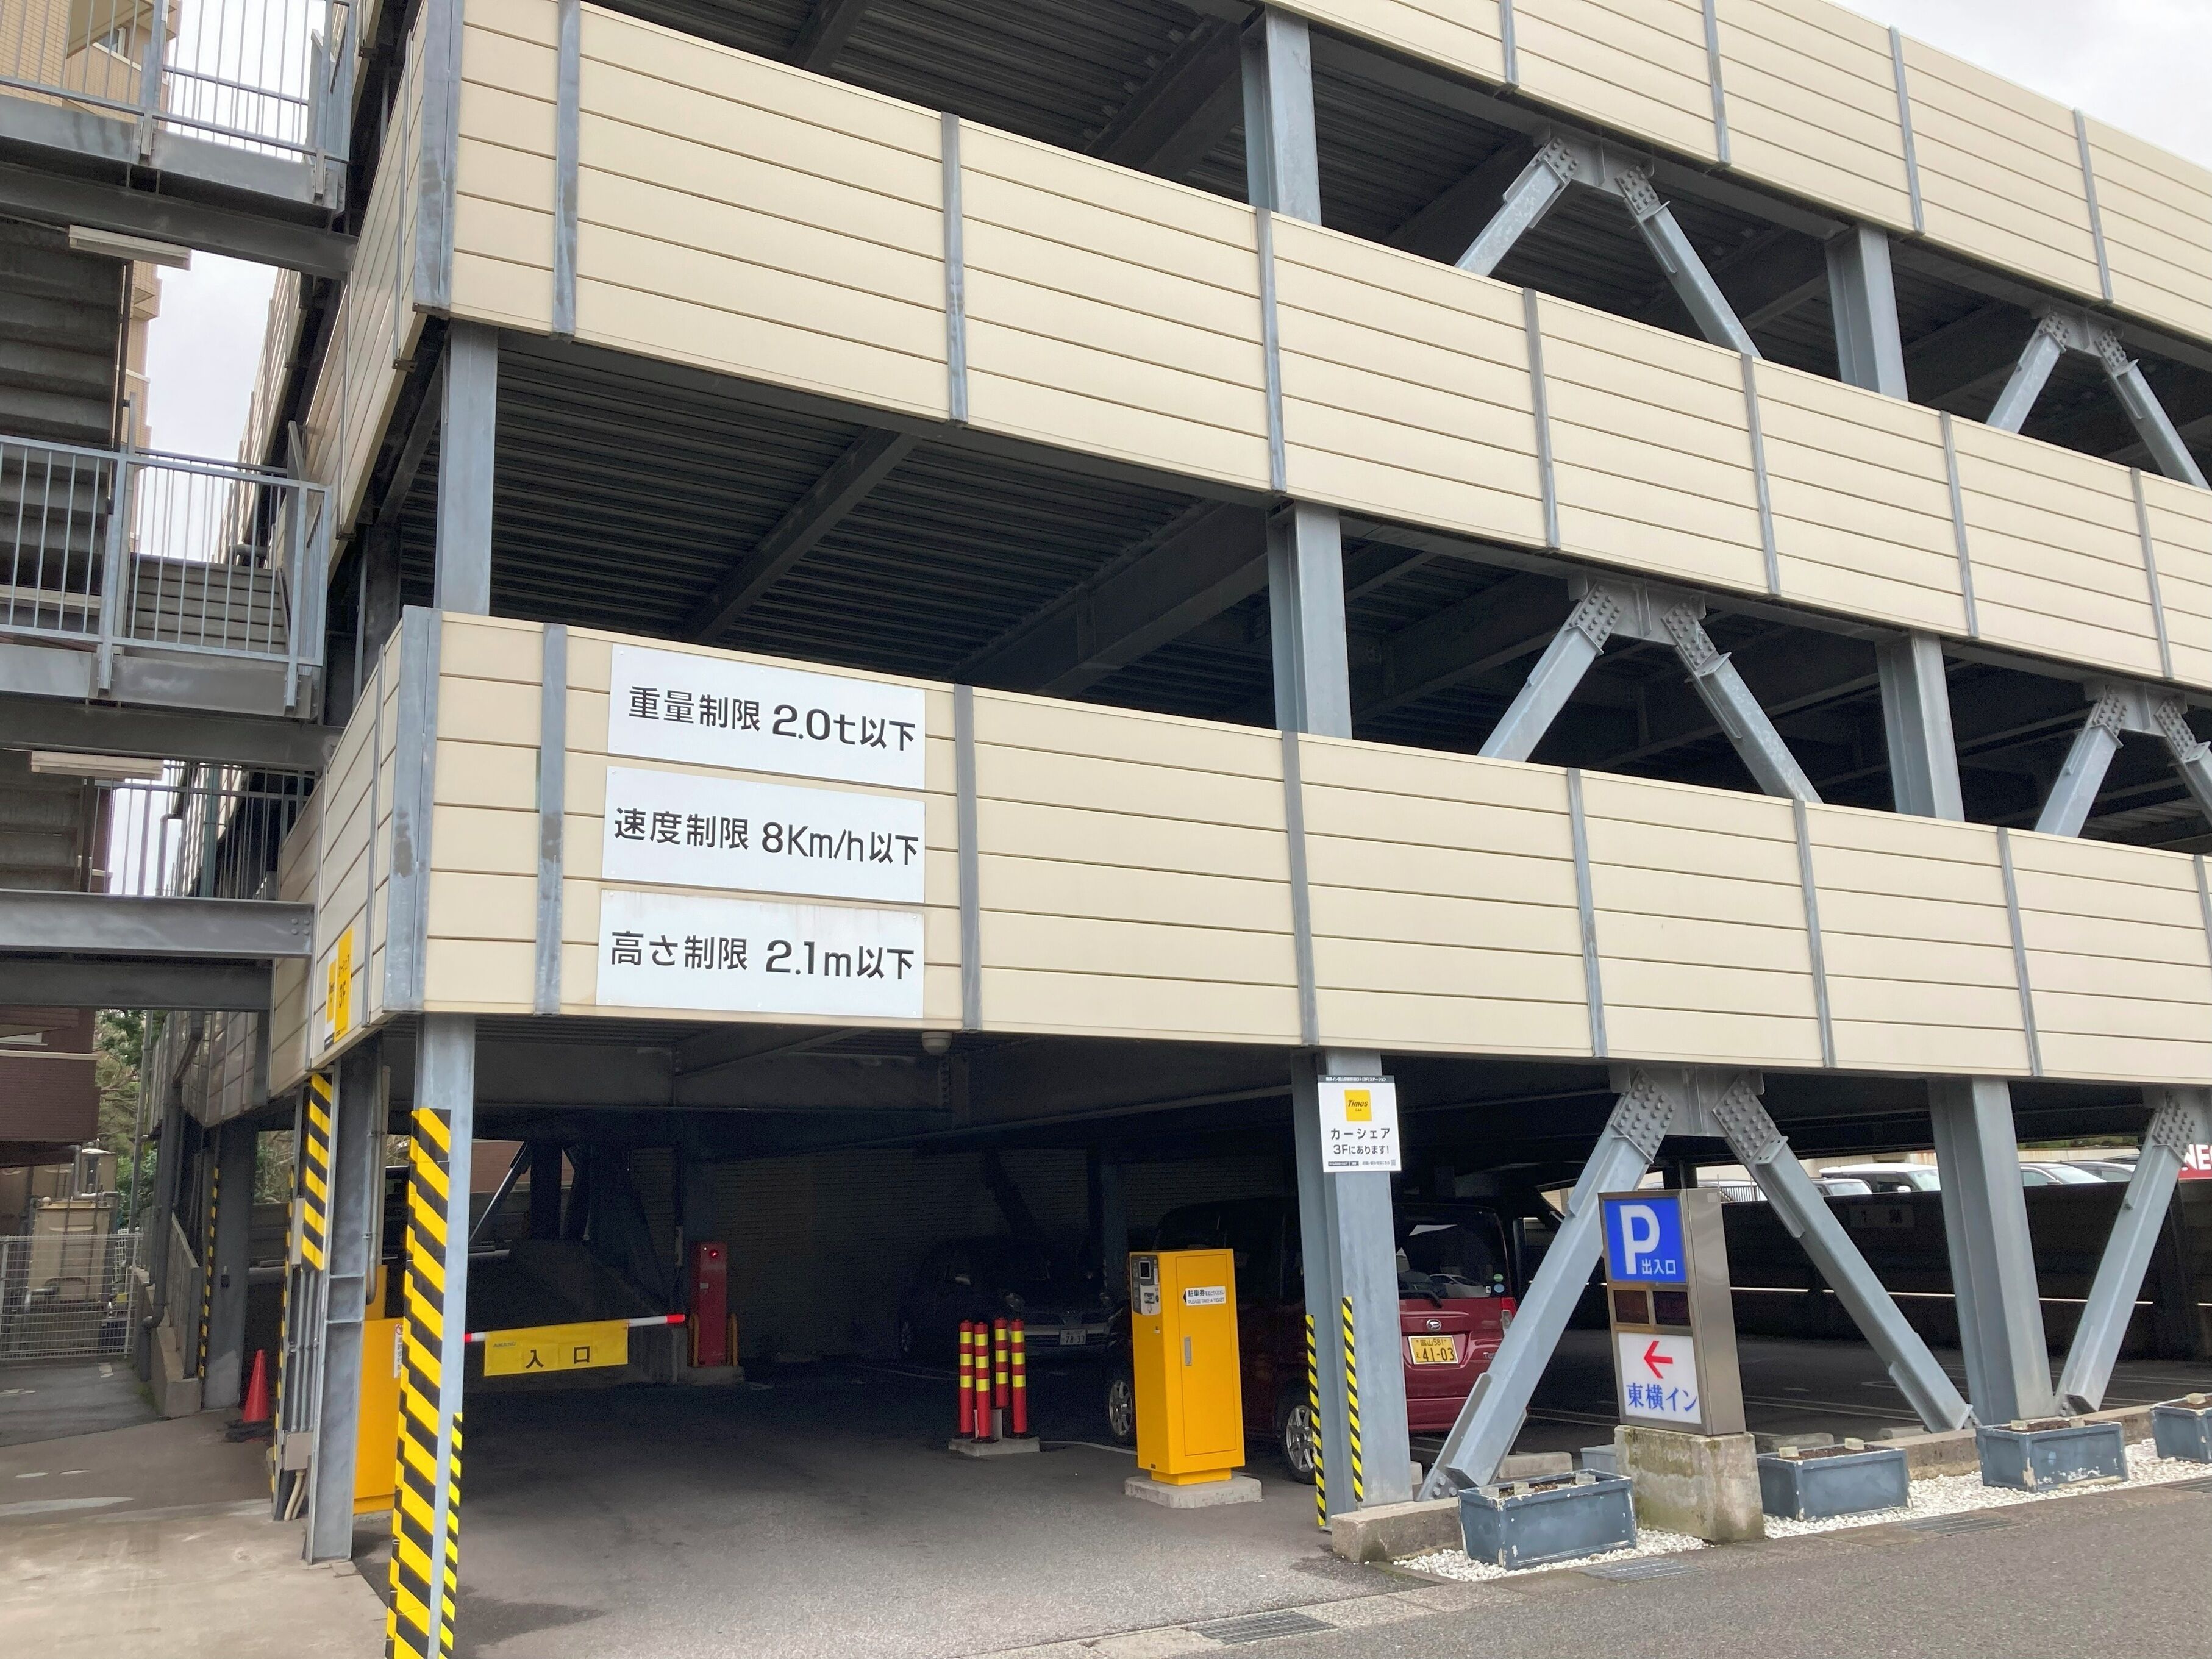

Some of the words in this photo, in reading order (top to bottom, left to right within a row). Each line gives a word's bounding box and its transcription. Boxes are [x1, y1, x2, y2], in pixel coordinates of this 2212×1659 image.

[629, 686, 760, 732] 重量制限
[772, 705, 916, 751] 2.0t以下
[614, 807, 749, 850] 速度制限
[762, 822, 919, 865] 8Km/h以下
[611, 930, 748, 970] 高さ制限
[766, 940, 914, 979] 2.1m以下
[1331, 1128, 1390, 1140] カーシェア
[1619, 1204, 1660, 1275] P
[1642, 1259, 1676, 1275] 出入口
[526, 1346, 590, 1369] 入口
[1626, 1382, 1698, 1413] 東横イン
